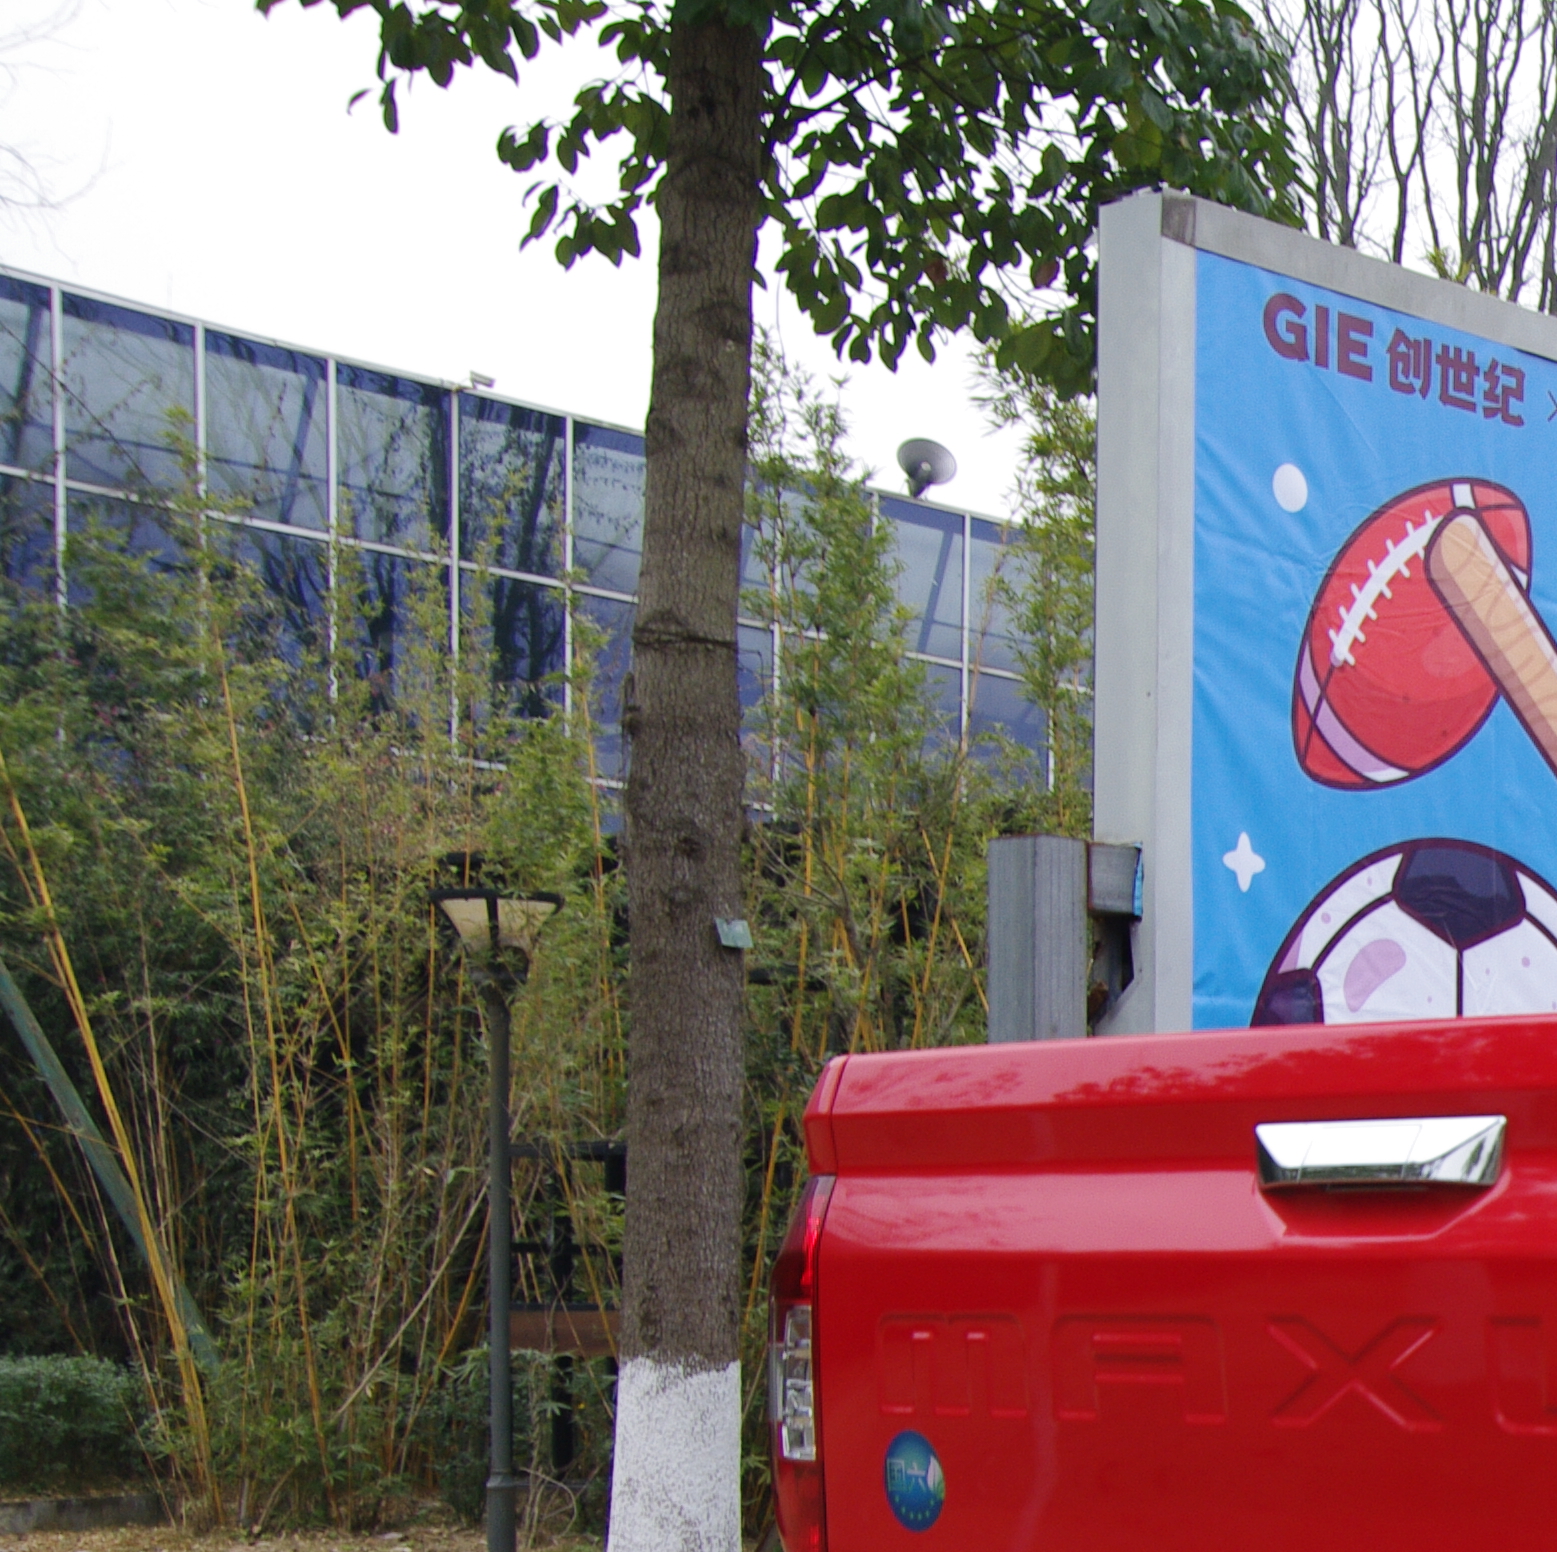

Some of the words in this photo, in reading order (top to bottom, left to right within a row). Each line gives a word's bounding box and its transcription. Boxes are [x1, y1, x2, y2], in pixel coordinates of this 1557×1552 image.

[1262, 291, 1375, 382] GIE
[1386, 326, 1526, 427] 创世纪
